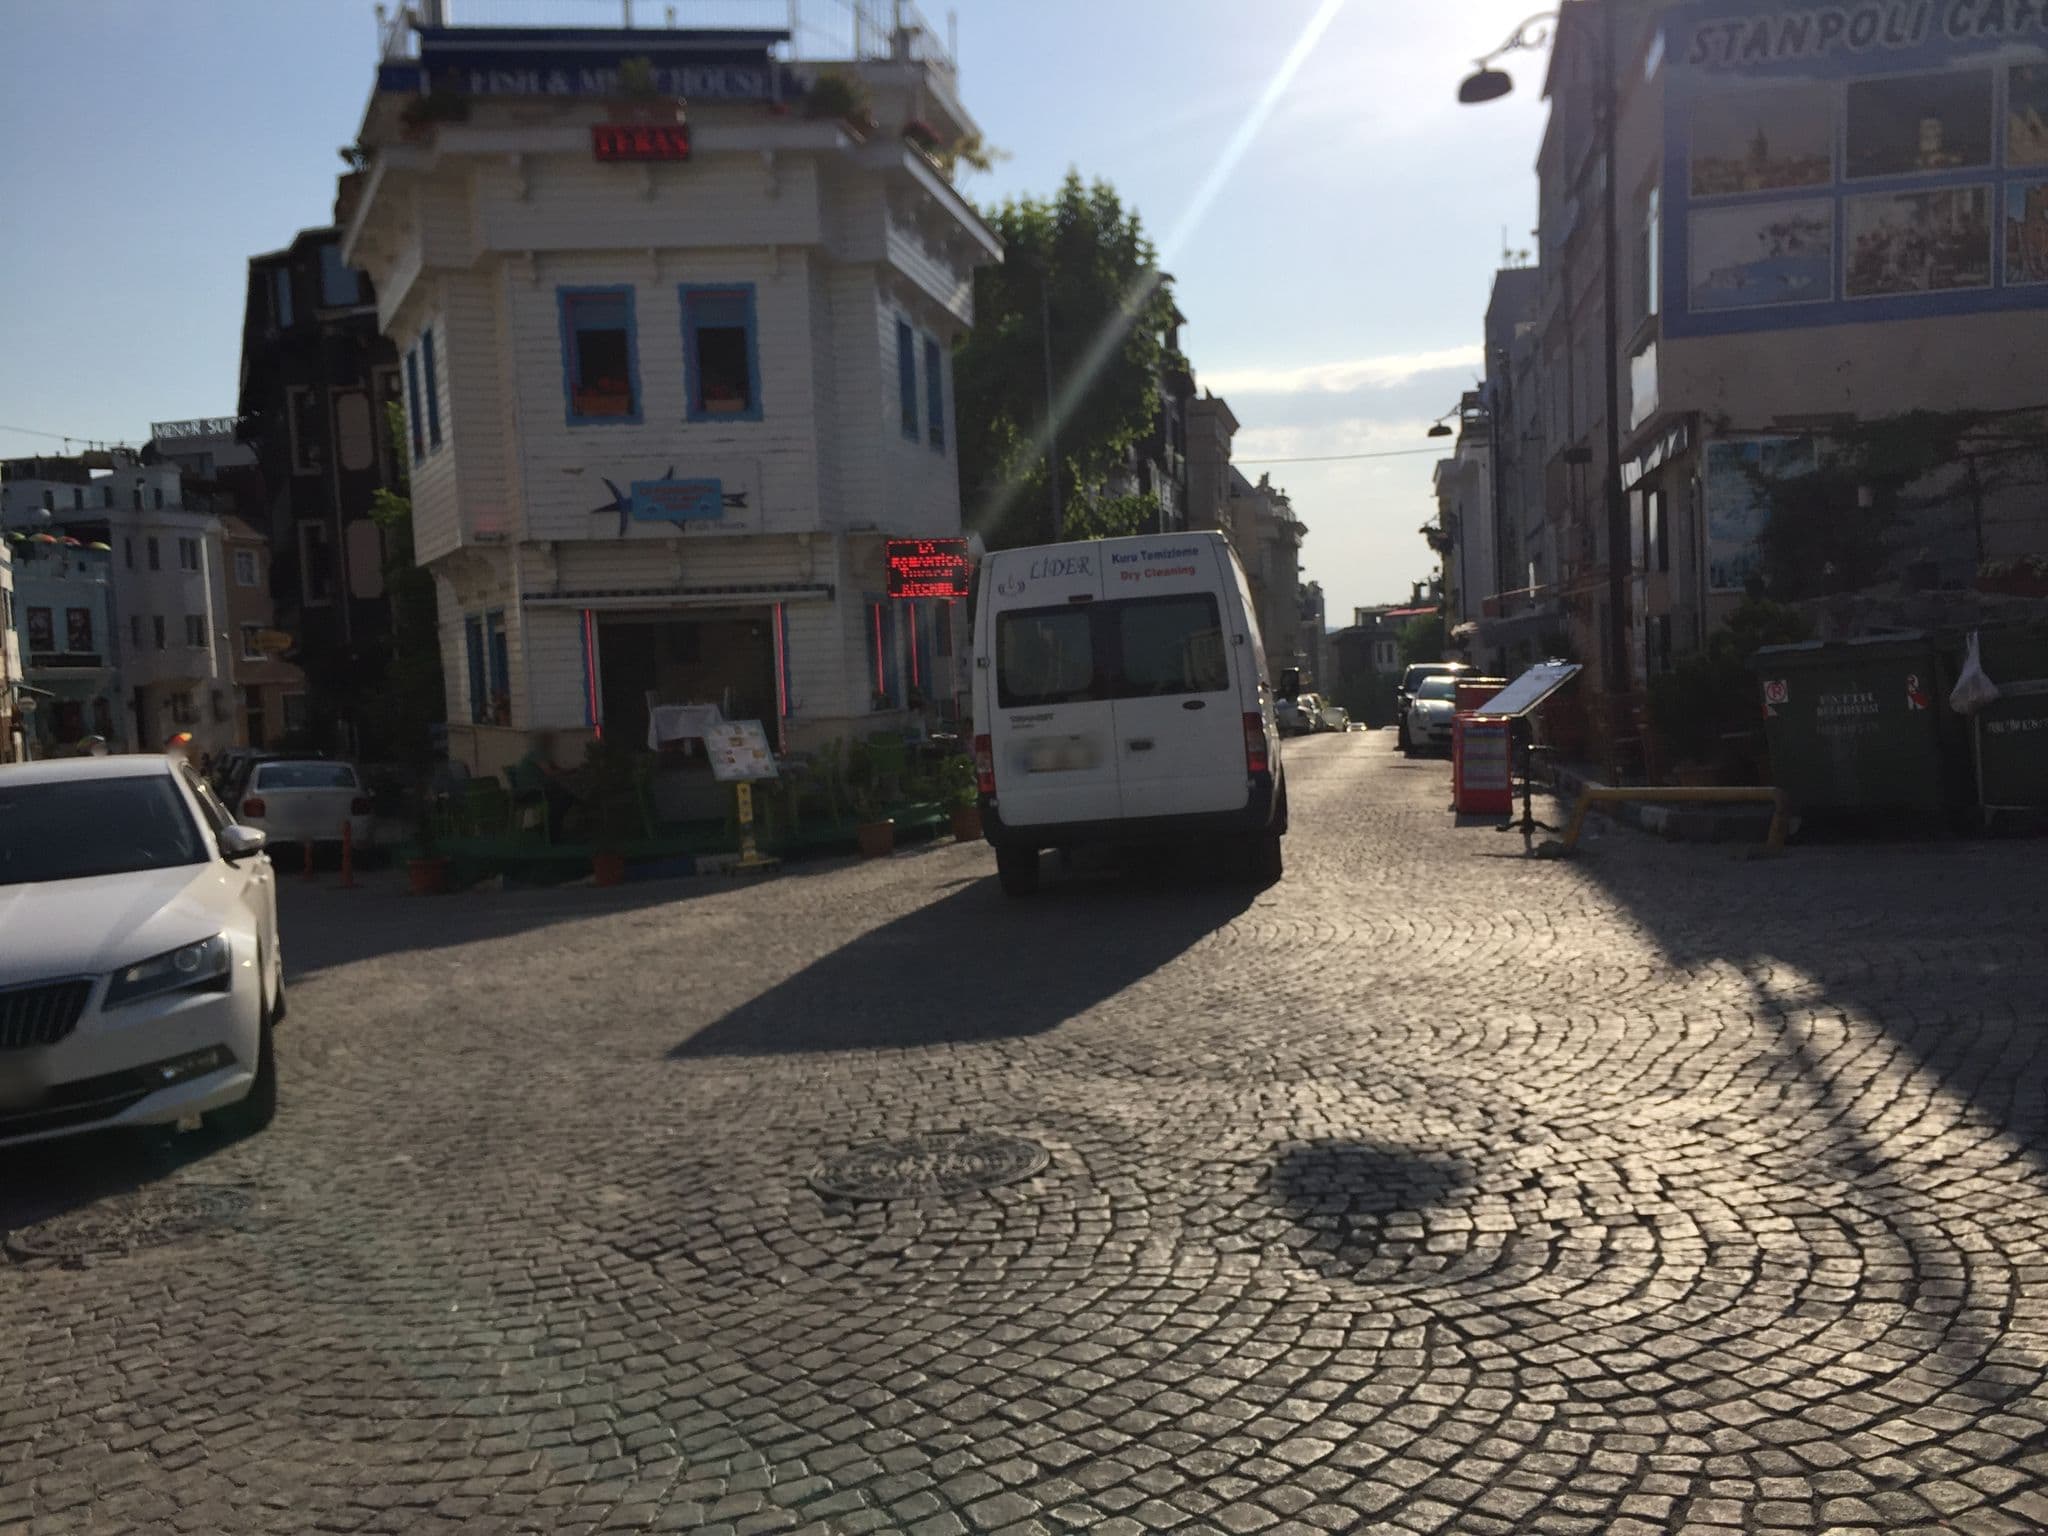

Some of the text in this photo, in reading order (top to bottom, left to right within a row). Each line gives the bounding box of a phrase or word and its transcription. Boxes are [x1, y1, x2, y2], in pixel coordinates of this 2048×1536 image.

[1688, 0, 2048, 65] STANPOLI CAF
[1111, 546, 1200, 565] Kuru Temizleme
[1029, 556, 1094, 580] LİDER
[1120, 565, 1197, 582] Dry Cleaning
